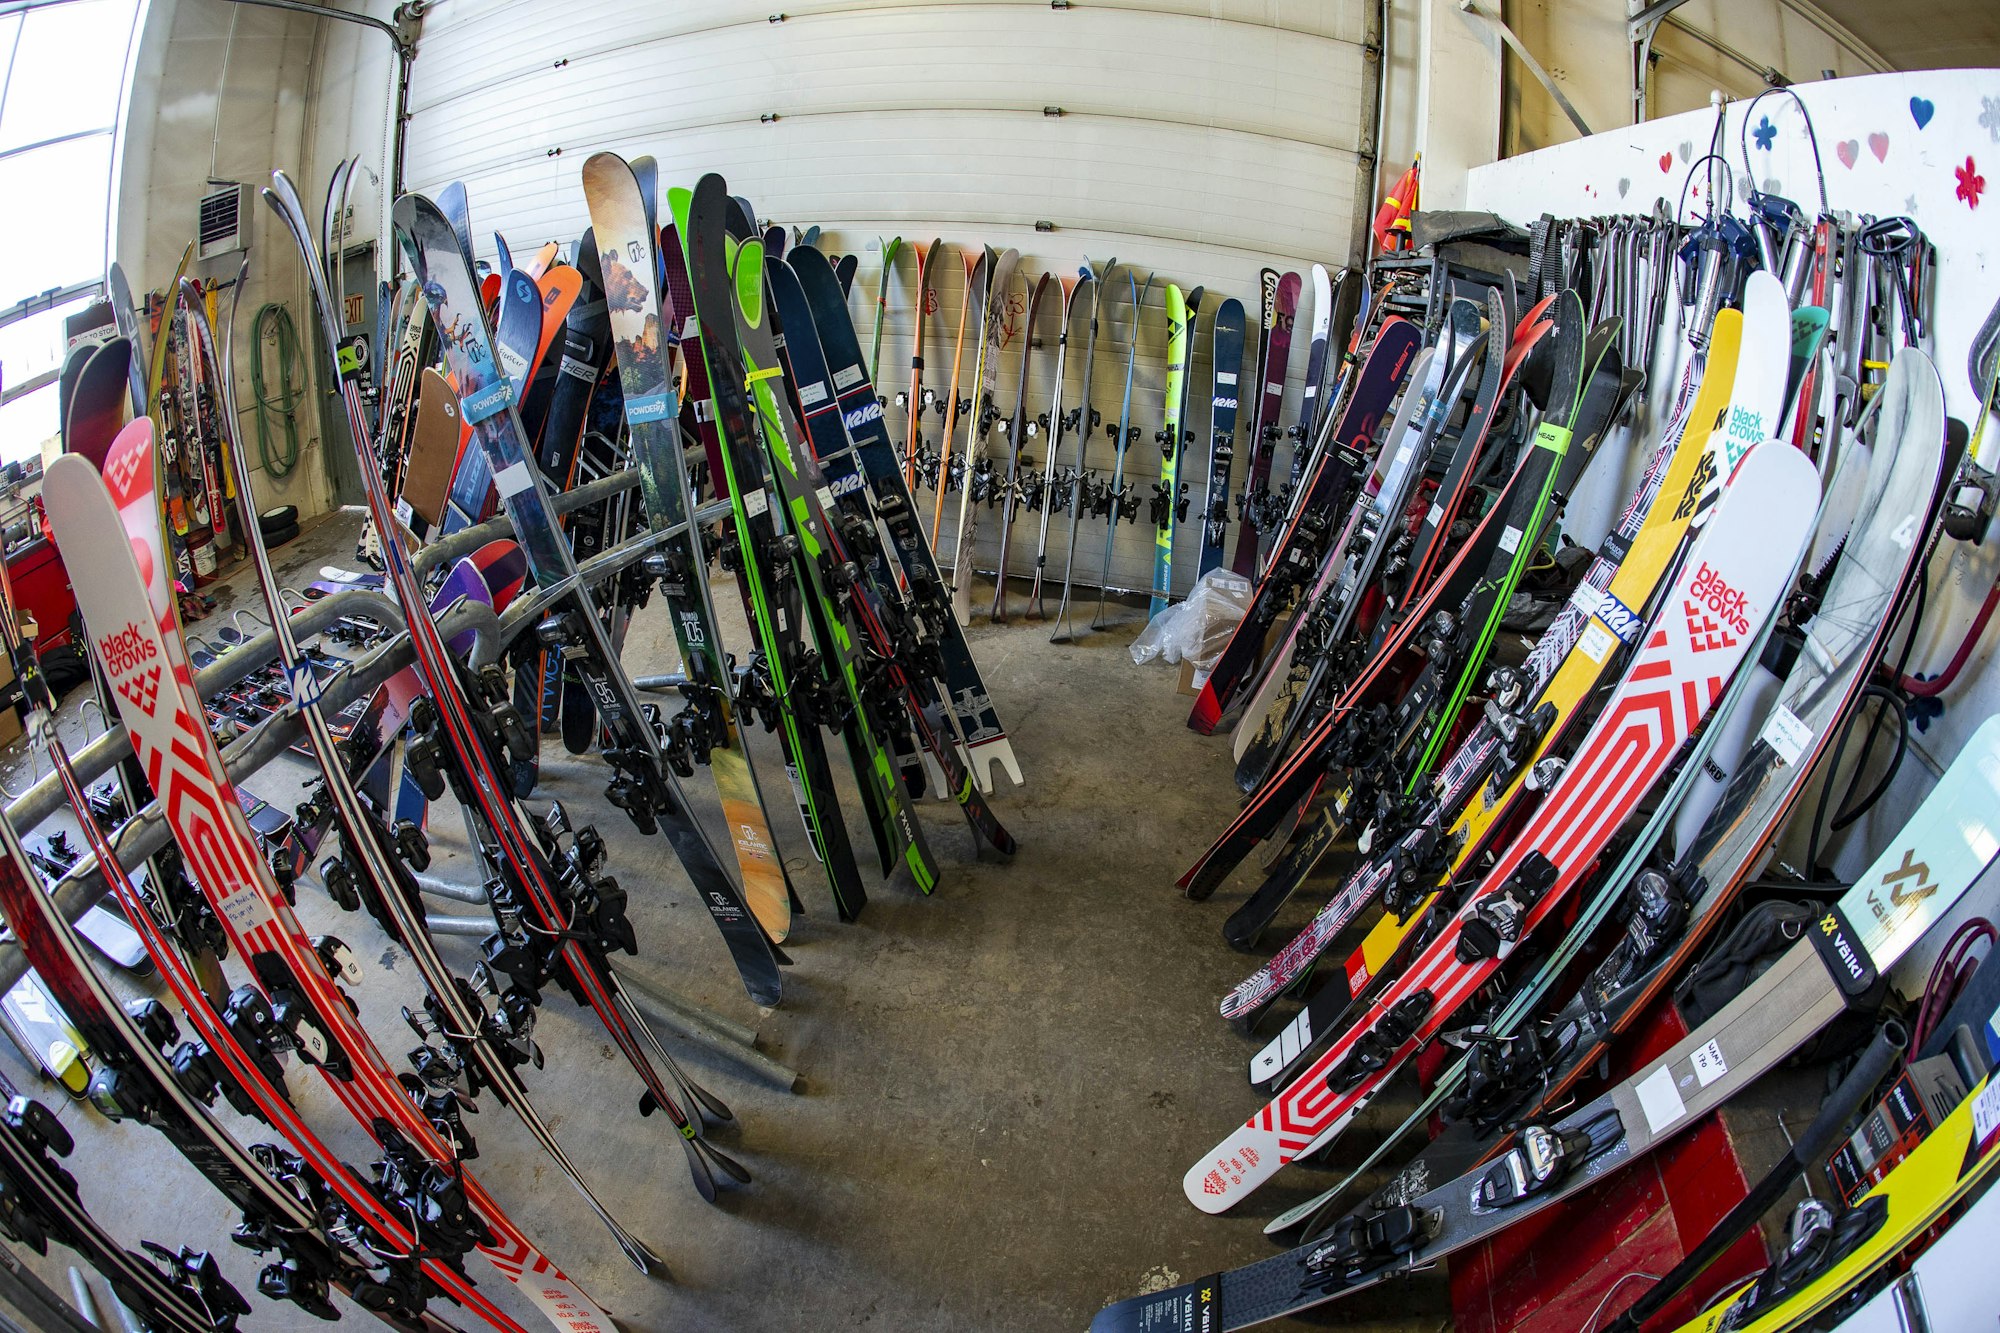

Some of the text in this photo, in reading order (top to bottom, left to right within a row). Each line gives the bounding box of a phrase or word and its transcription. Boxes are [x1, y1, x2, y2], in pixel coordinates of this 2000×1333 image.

[99, 326, 115, 337] STOP
[473, 391, 504, 412] POWDER
[629, 403, 658, 416] POWDER
[1733, 404, 1763, 430] black
[1538, 431, 1556, 442] HEAD
[1729, 422, 1764, 443] crows
[1693, 450, 1716, 477] K2
[1683, 474, 1706, 500] K2
[1671, 497, 1696, 522] K2
[1696, 561, 1749, 615] black
[1690, 581, 1750, 635] crows
[99, 622, 143, 661] black
[682, 621, 704, 642] 105
[108, 639, 157, 677] crows
[594, 682, 617, 704] 95
[1704, 759, 1724, 781] ARD
[900, 809, 914, 842] FX106
[1834, 932, 1864, 979] Völkl
[1893, 1086, 1914, 1122] Schauer
[1239, 1148, 1257, 1168] birdie
[1246, 1147, 1260, 1162] atris
[1208, 1173, 1226, 1193] crows
[1211, 1169, 1227, 1187] black
[1218, 1160, 1241, 1185] 10.8 20
[1184, 1293, 1193, 1332] Völkl
